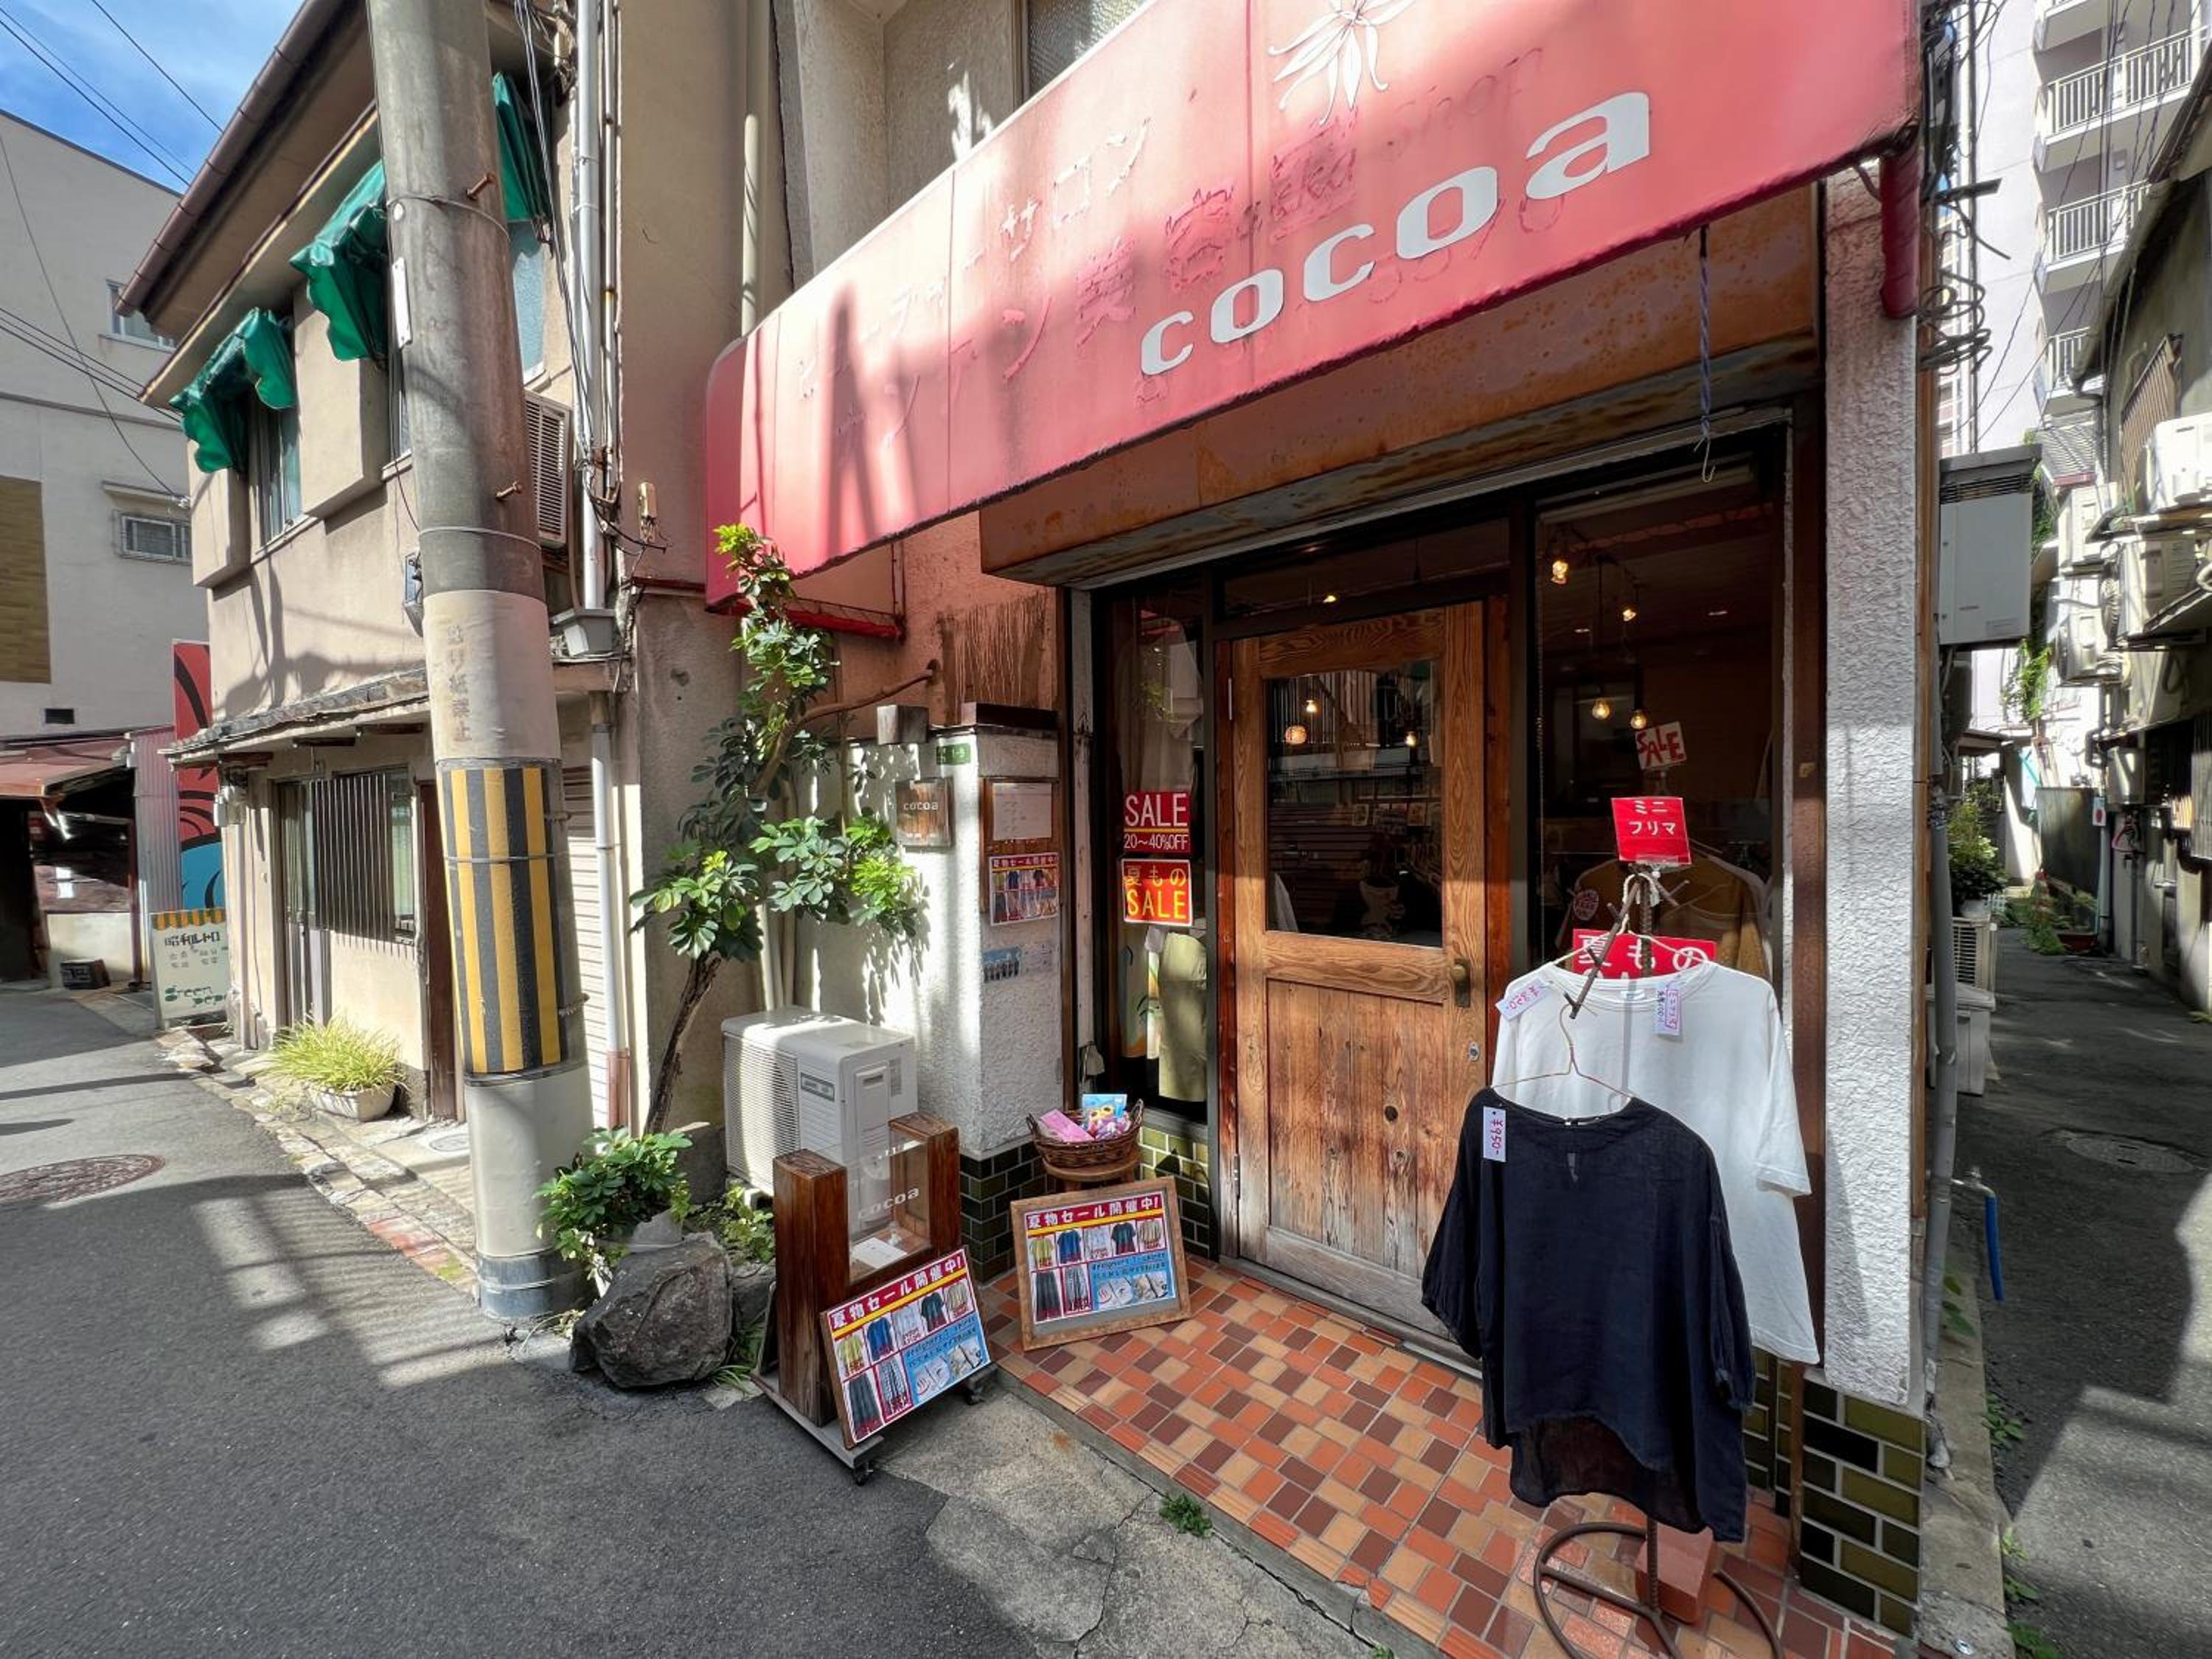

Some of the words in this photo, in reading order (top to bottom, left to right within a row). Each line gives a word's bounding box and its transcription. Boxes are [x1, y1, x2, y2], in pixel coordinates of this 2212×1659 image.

[1140, 91, 1650, 376] cocoa
[1637, 728, 1685, 767] SALE
[903, 801, 939, 812] cocoa
[1124, 793, 1188, 827] SALE
[1633, 799, 1668, 815] ミニ
[1628, 821, 1676, 835] フリマ
[1124, 864, 1186, 887] 夏もの
[1127, 888, 1187, 920] SALE
[164, 985, 213, 1002] green
